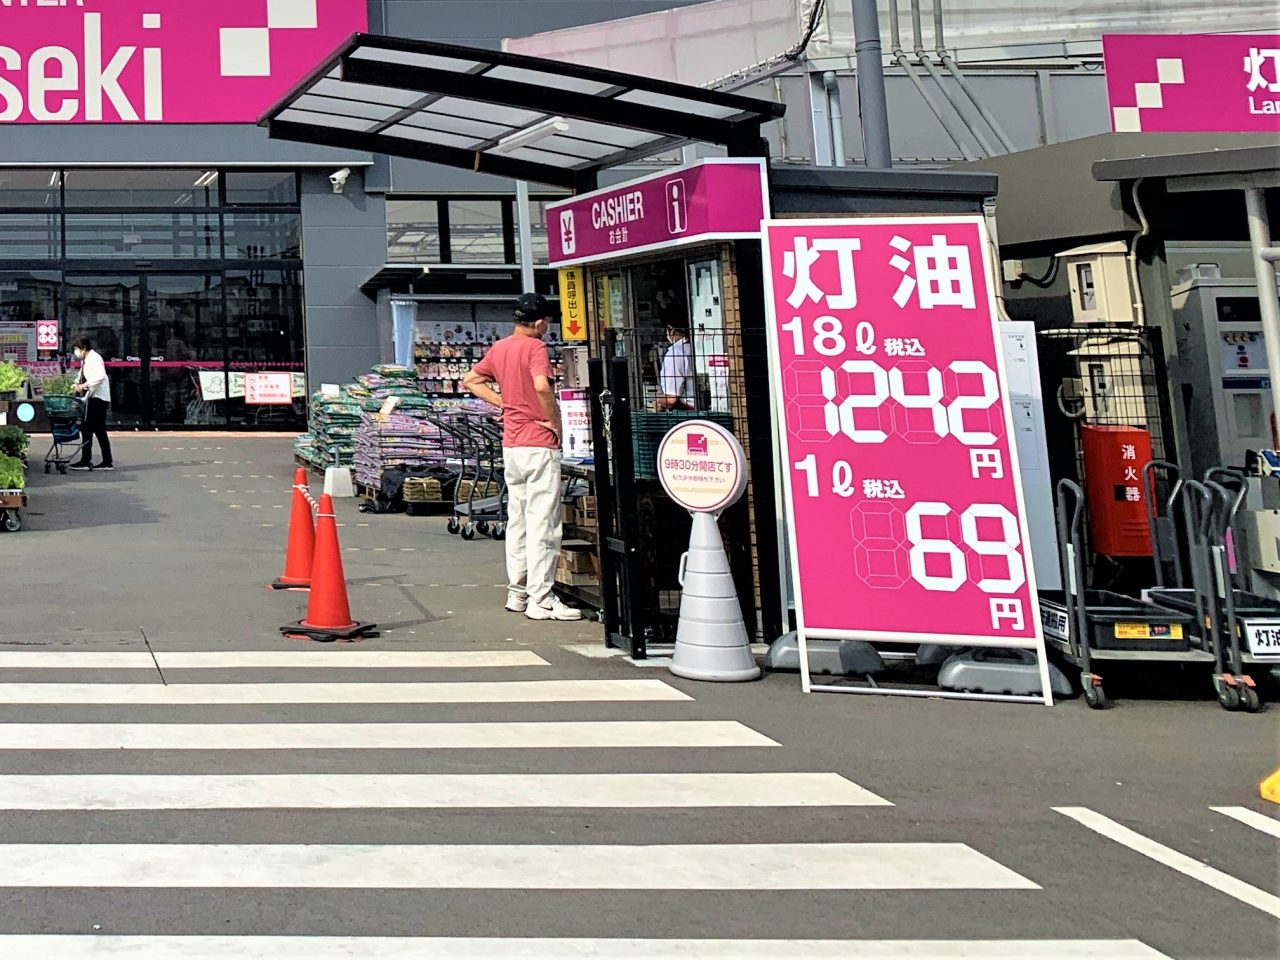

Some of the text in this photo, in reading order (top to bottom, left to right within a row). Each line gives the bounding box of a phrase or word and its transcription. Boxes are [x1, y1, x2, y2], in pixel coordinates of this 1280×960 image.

[592, 191, 645, 230] CASHIER
[609, 227, 628, 245] お会計
[782, 235, 977, 310] 灯油
[883, 338, 926, 357] 税込
[820, 360, 1000, 446] 1242
[664, 459, 733, 473] 9時30分開店です
[969, 448, 1004, 479] 円
[1121, 443, 1141, 502] 消火器
[862, 479, 906, 499] 税込
[905, 501, 1026, 594] 69
[989, 598, 1025, 630] 円
